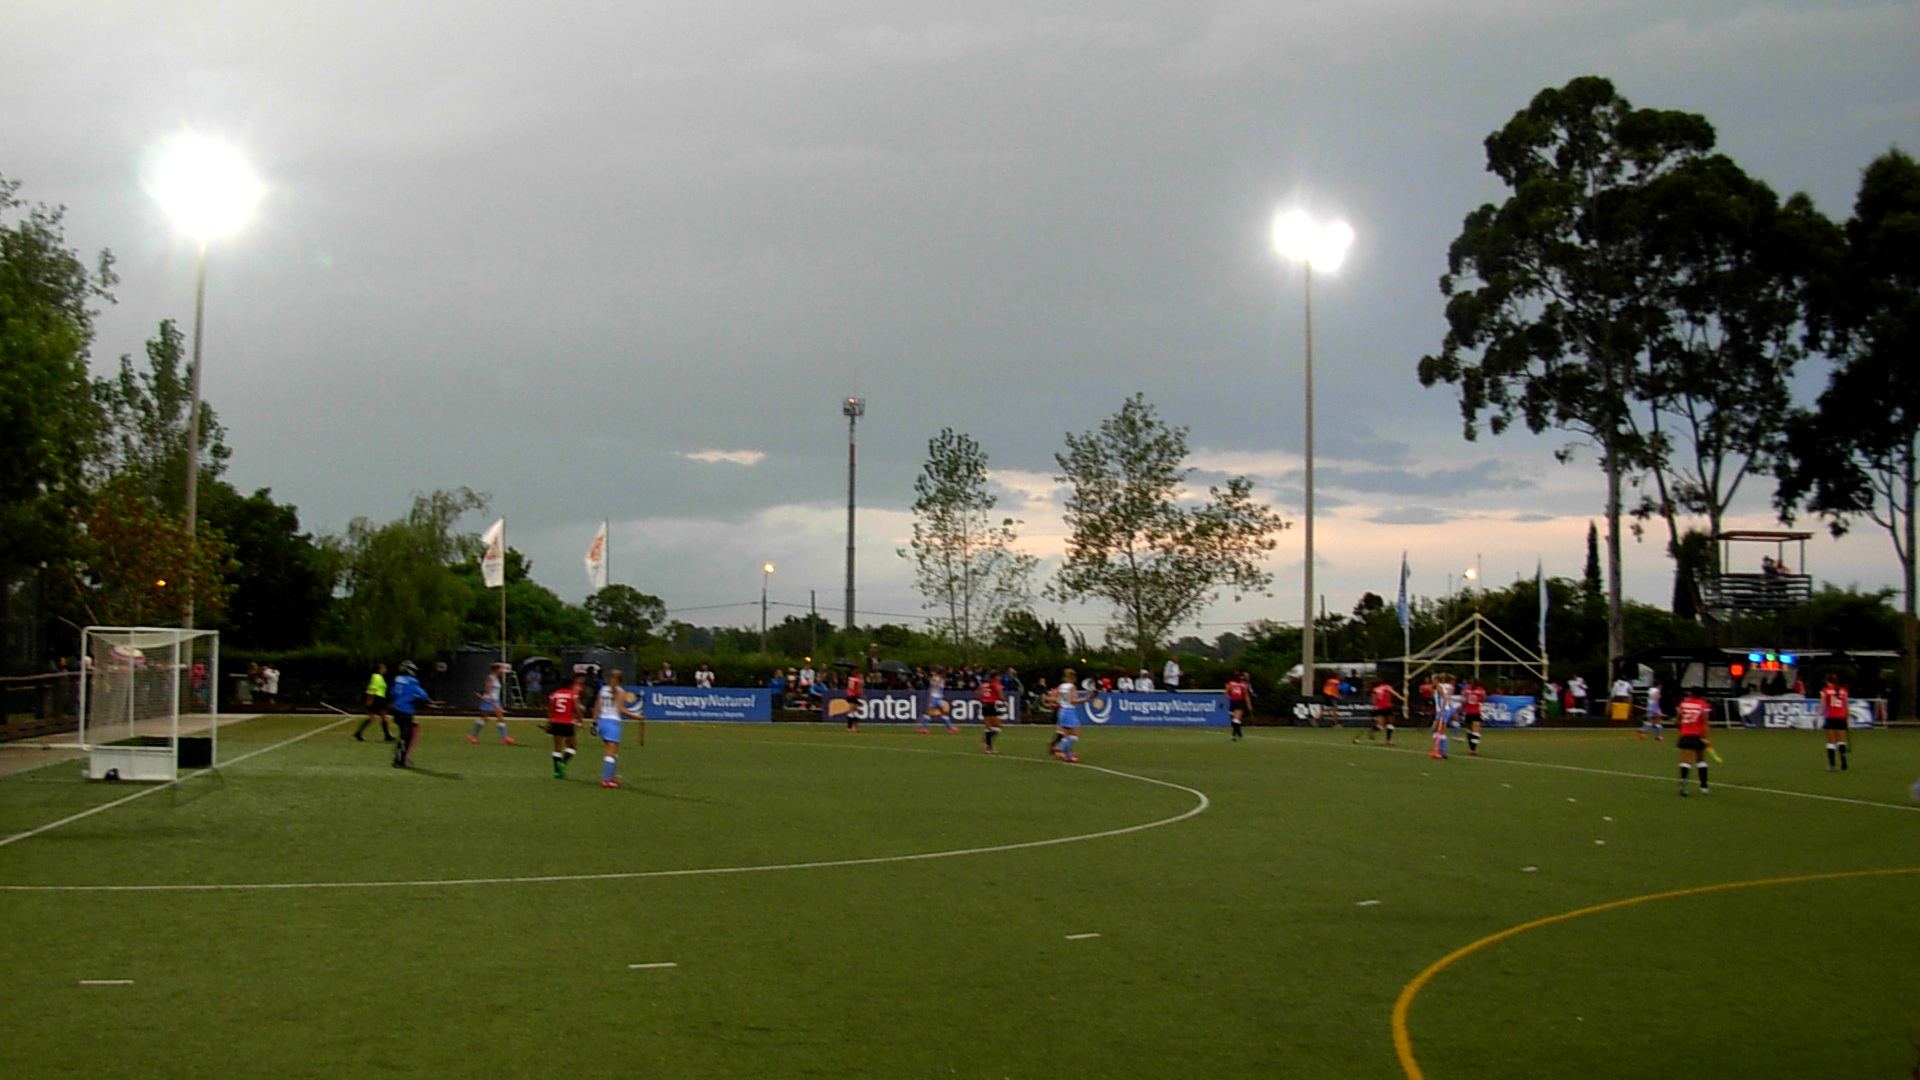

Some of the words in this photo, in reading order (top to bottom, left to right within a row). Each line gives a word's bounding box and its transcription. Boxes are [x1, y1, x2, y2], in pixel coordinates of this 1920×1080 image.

[555, 698, 567, 713] 5
[652, 692, 756, 709] UruguayNatural
[856, 694, 917, 720] antel
[951, 695, 1016, 720] anel
[1118, 698, 1216, 714] UruguayNatural
